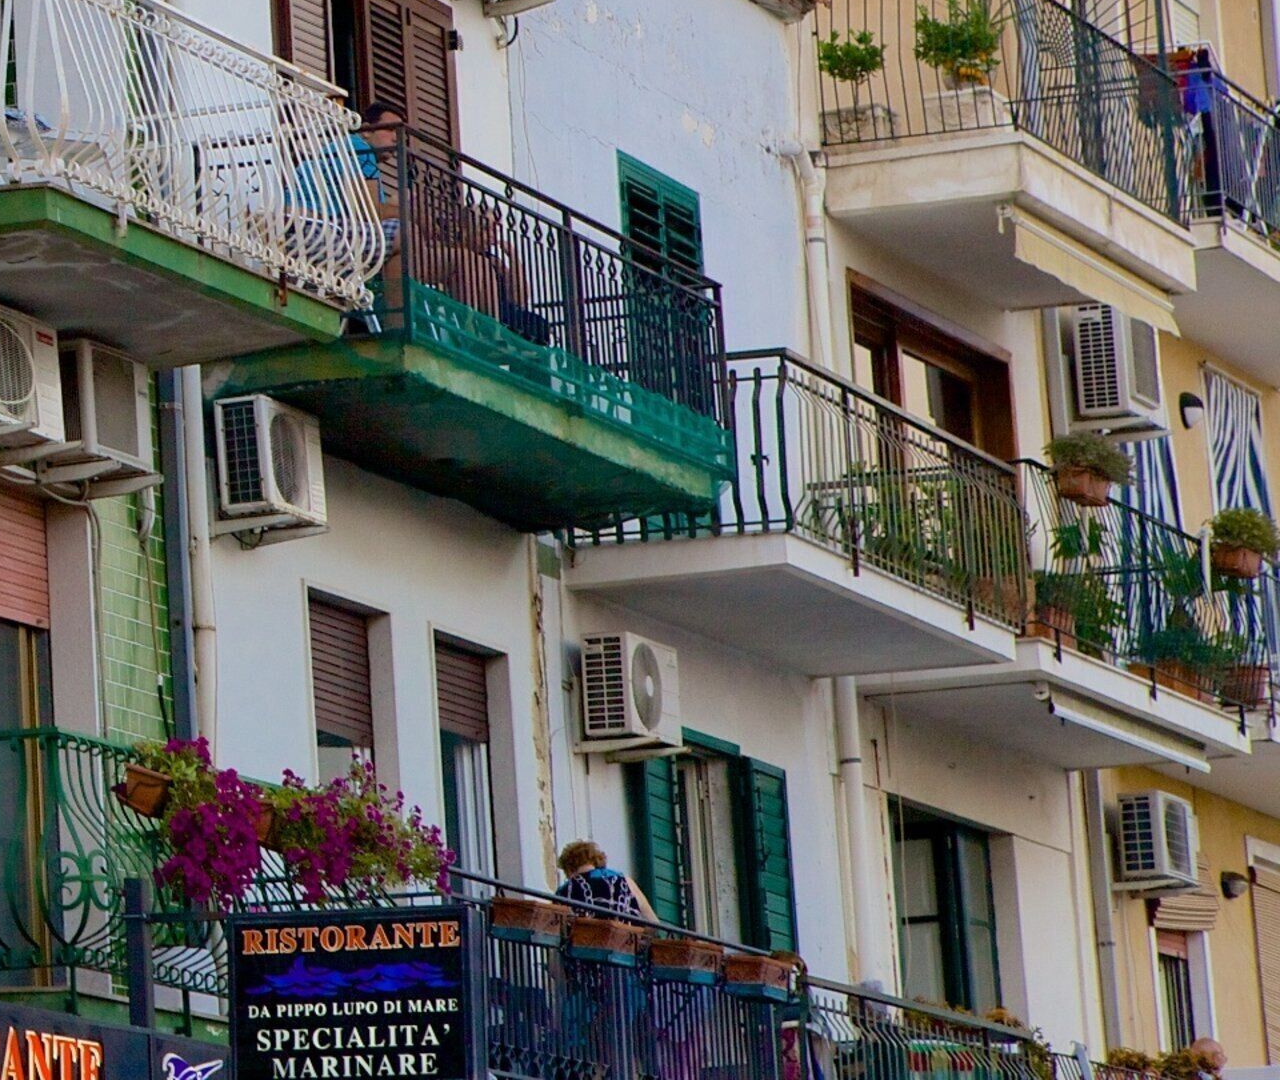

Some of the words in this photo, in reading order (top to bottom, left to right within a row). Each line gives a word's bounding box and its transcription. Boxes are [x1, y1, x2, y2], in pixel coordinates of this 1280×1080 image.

[241, 920, 462, 956] RISTORANTE
[247, 1003, 272, 1019] DA
[276, 1001, 328, 1018] PIPPO
[332, 1000, 379, 1016] LUPO
[383, 999, 402, 1015] DI
[407, 997, 459, 1013] MARE
[272, 1052, 440, 1080] MARINARE
